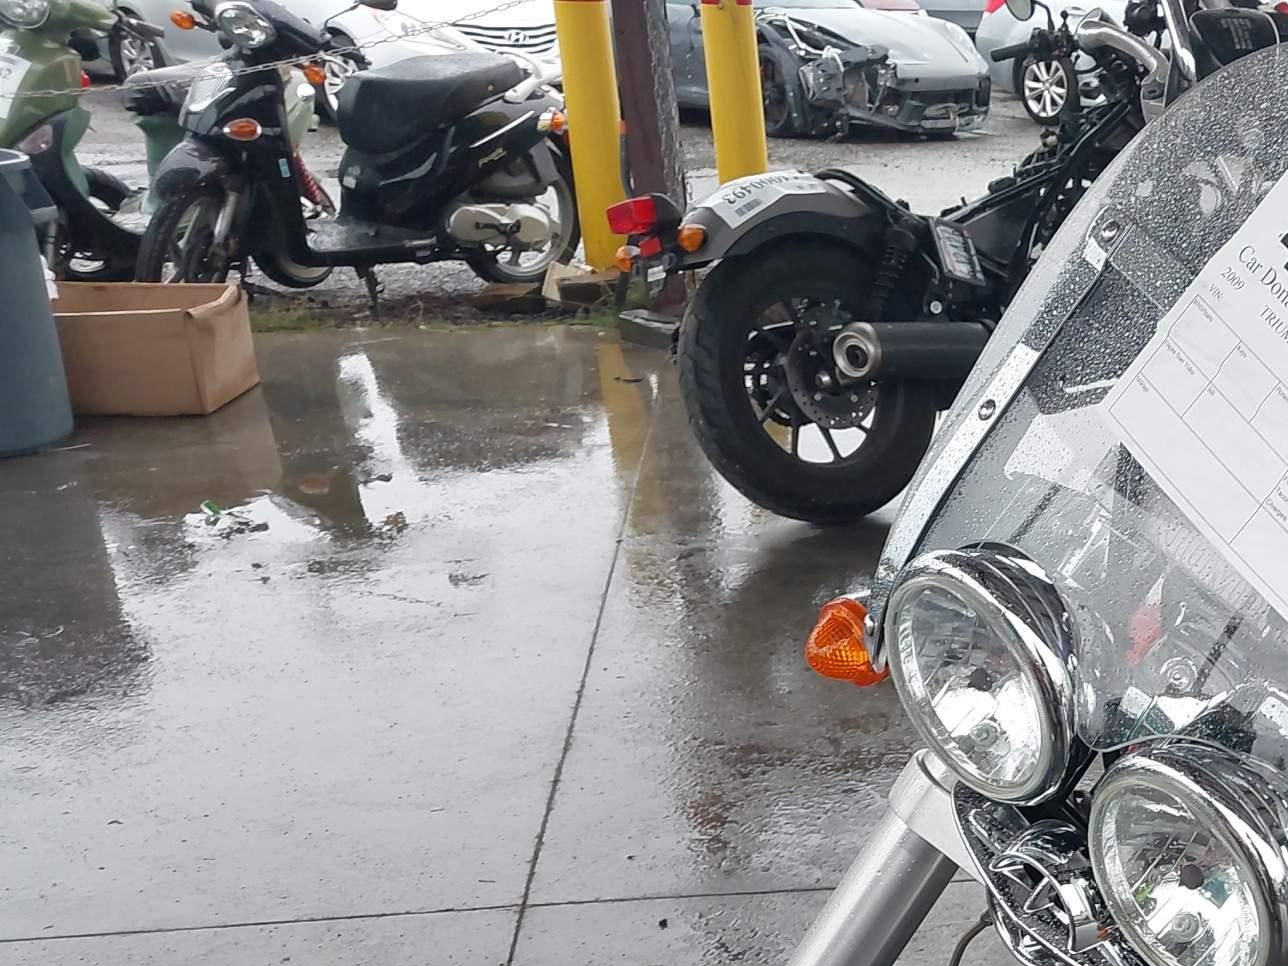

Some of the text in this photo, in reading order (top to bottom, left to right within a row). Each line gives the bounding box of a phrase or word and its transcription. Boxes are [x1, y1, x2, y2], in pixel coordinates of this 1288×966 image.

[1239, 245, 1265, 275] Car
[1221, 266, 1246, 290] 2009
[1207, 282, 1224, 303] VIN:
